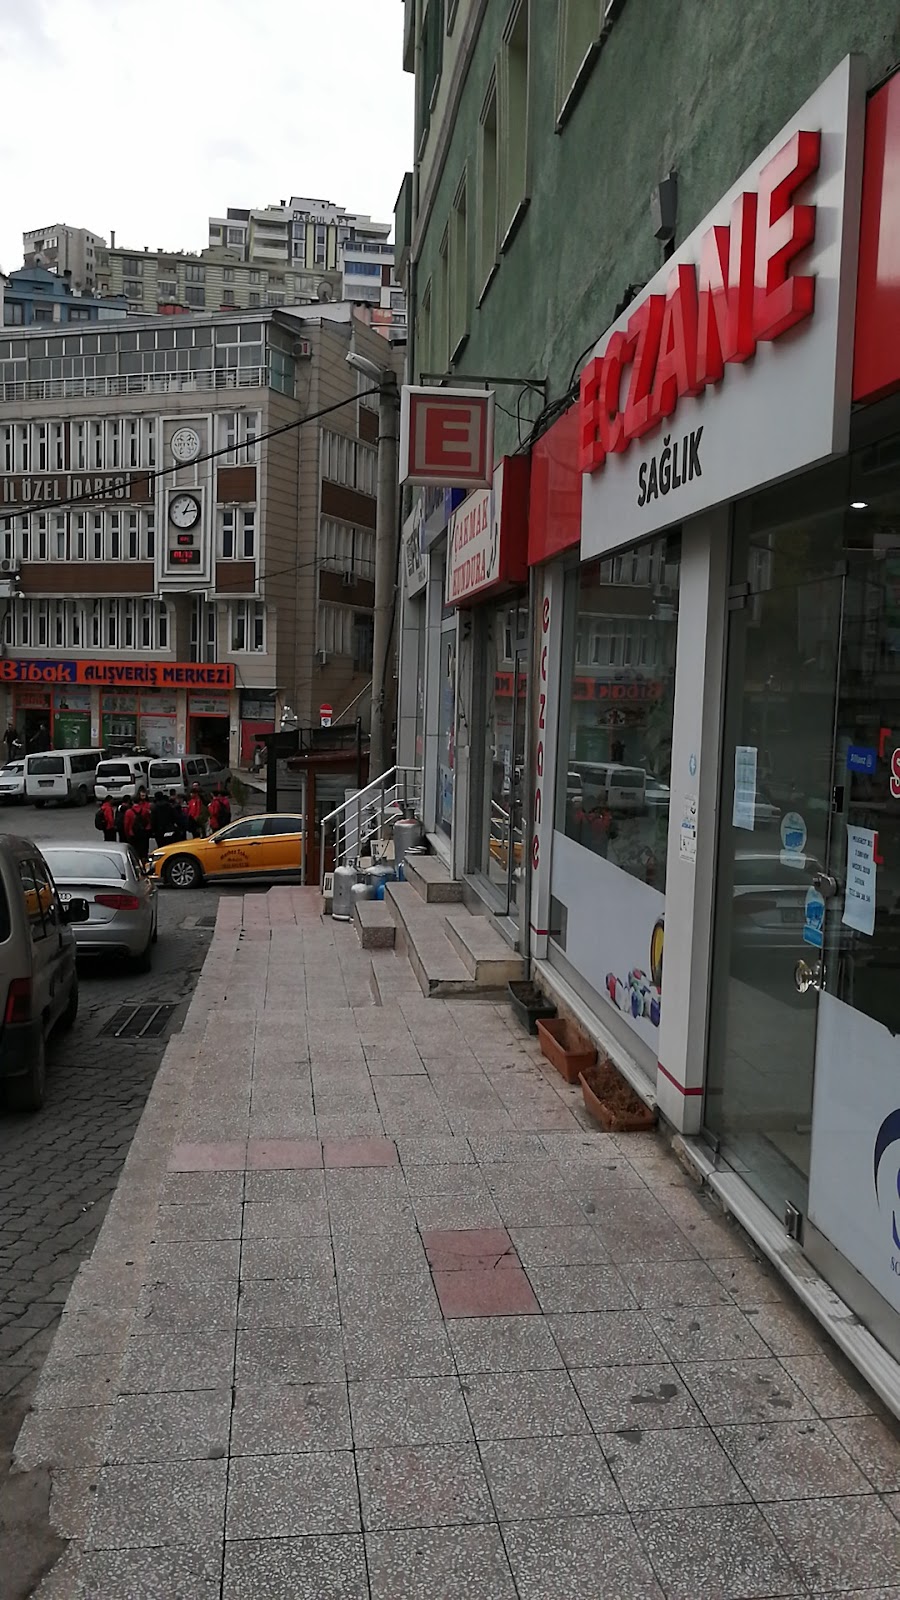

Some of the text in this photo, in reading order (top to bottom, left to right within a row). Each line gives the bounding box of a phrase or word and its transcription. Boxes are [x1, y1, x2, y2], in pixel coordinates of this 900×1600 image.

[579, 130, 821, 472] ECZANE
[425, 408, 471, 466] E
[3, 472, 131, 502] İL ÖZEL İDARESİ
[638, 426, 704, 507] SAĞLIK
[454, 496, 489, 561] ÇAKMAK
[453, 549, 486, 597] KUNDURA
[84, 663, 158, 686] ALIŞVERİŞ
[163, 665, 230, 683] MERKEZİ
